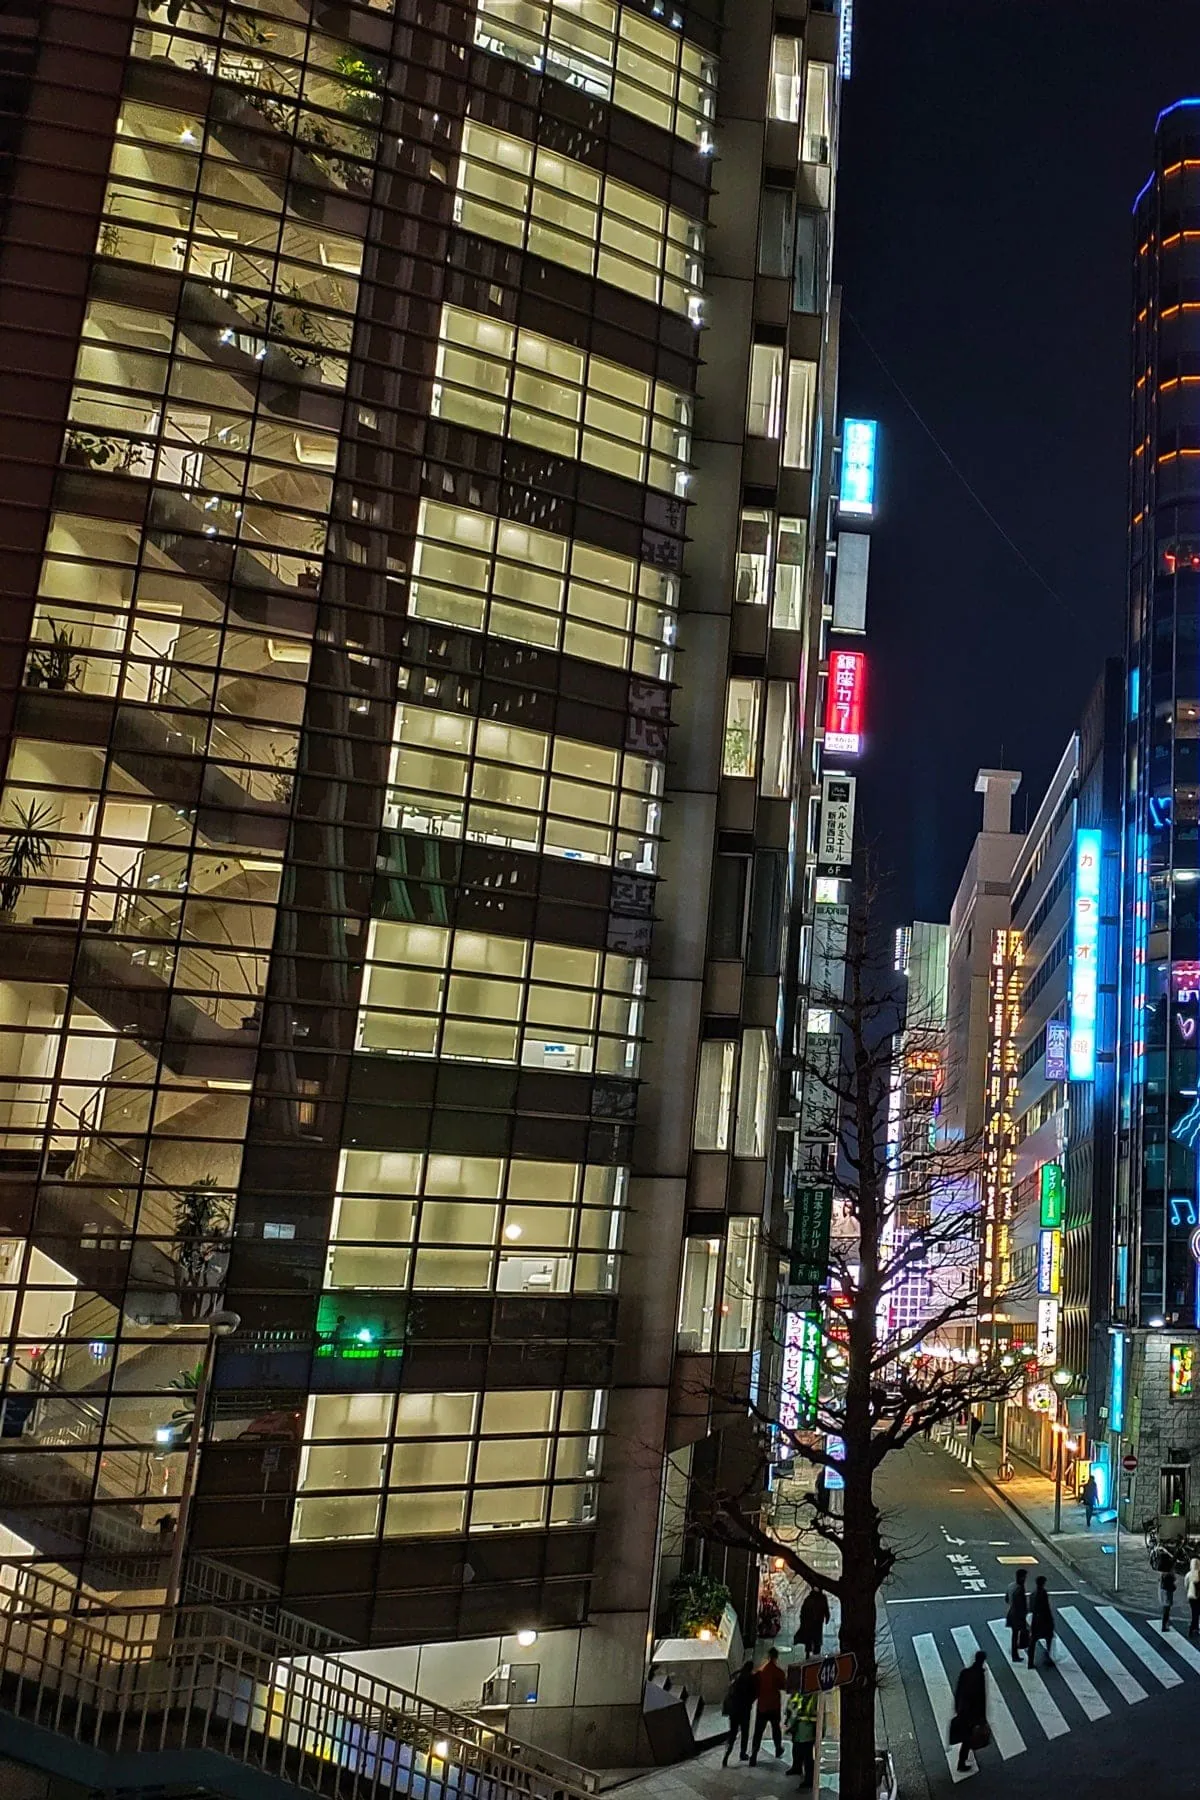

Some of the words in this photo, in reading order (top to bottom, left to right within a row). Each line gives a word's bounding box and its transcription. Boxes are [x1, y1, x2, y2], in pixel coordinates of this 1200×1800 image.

[836, 654, 856, 731] 銀座カラー
[827, 866, 841, 874] 6F
[1073, 854, 1094, 1054] カラオケ館
[1048, 1026, 1065, 1058] 麻雀
[821, 1663, 835, 1683] 414
